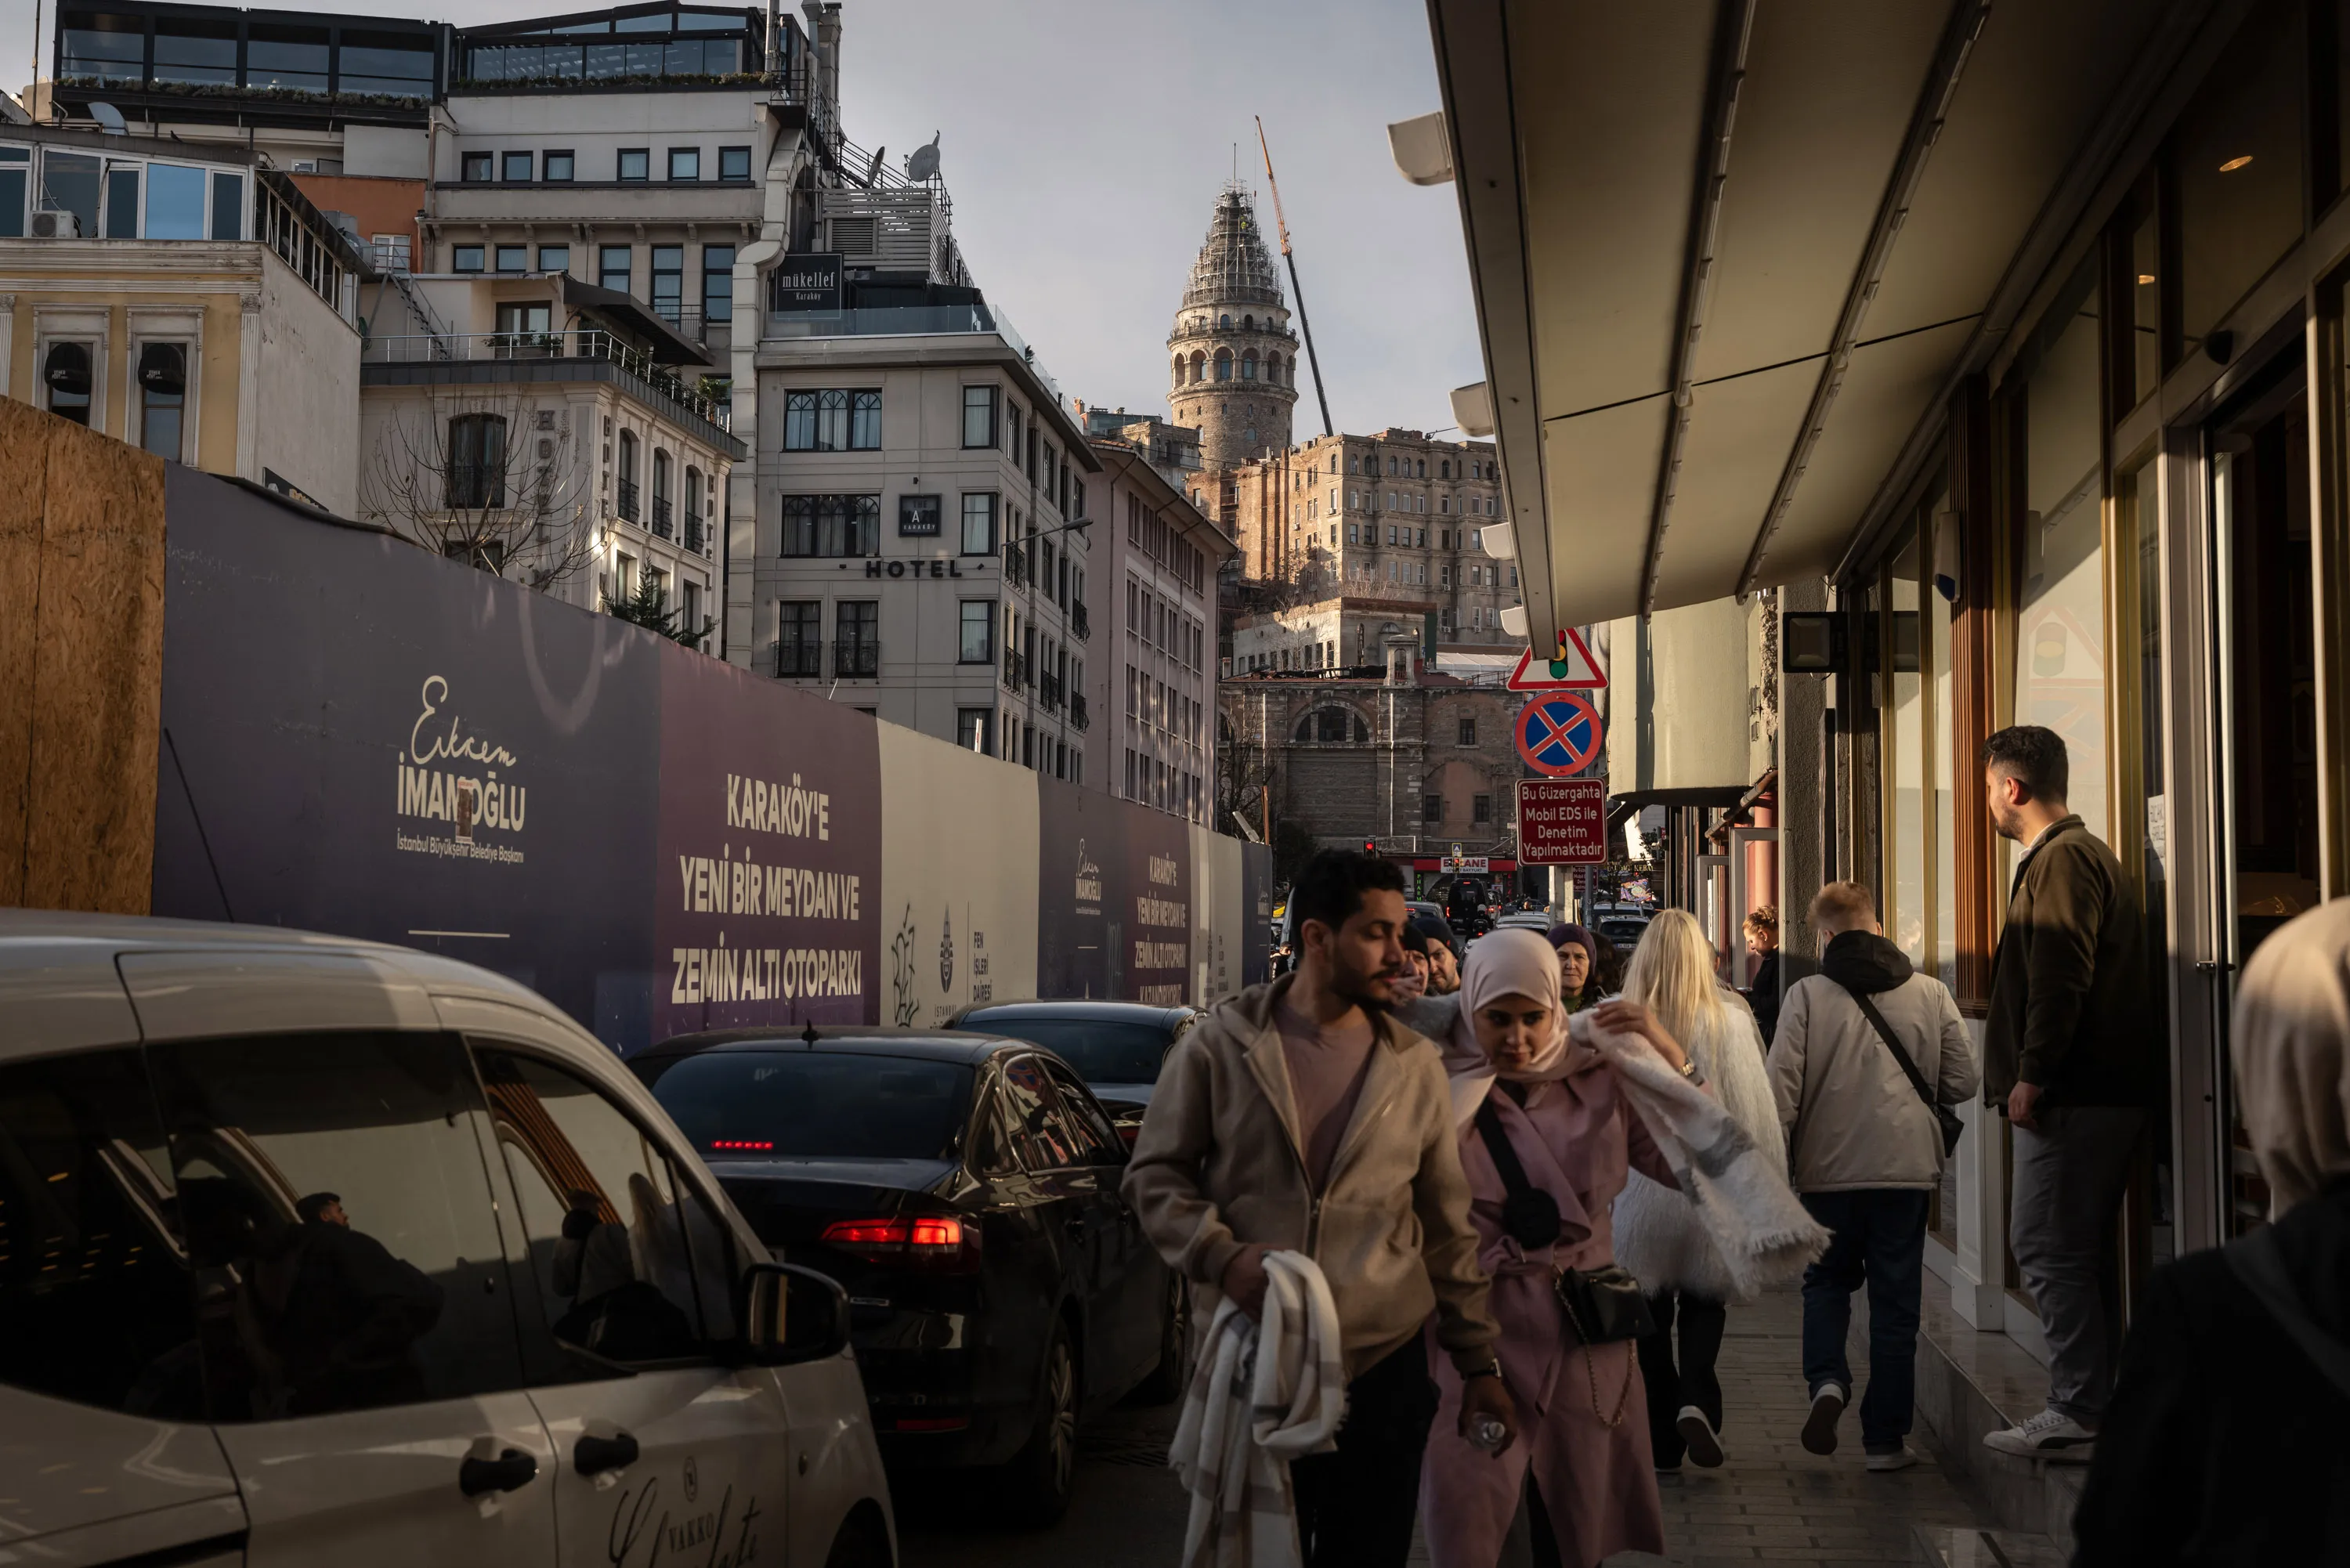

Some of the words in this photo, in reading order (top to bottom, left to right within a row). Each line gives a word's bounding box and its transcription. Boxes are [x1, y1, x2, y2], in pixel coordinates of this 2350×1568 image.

[783, 272, 835, 287] mükellef
[796, 292, 821, 301] Karaköy
[706, 474, 714, 591] HOTEL
[866, 560, 962, 578] HOTEL
[411, 675, 516, 767] Ekrem
[727, 772, 829, 841] KARAKÖY'E
[1522, 786, 1536, 800] Bu
[1538, 785, 1600, 802] Güzergahta
[1525, 807, 1556, 822] Mobil
[1559, 806, 1582, 821] EDS
[1584, 806, 1597, 820] ile
[1538, 825, 1588, 839] Denetim
[397, 827, 429, 852] İstanbul
[470, 842, 497, 863] Belediye
[498, 845, 524, 865] Başkanı
[1523, 841, 1603, 860] Yapılmaktadır
[1444, 858, 1487, 868] EANE
[679, 843, 728, 913] YENİ
[732, 846, 762, 916] BİR
[765, 865, 837, 919] MEYDAN
[841, 874, 859, 920] VE
[1137, 889, 1151, 925] YENİ
[974, 931, 984, 949] FEN
[1135, 933, 1153, 968] ZEMİN
[671, 930, 738, 1004] ZEMİN
[740, 948, 780, 1001] ALTI
[783, 948, 861, 999] OTOPARKI
[668, 1512, 714, 1554] VAKKO
